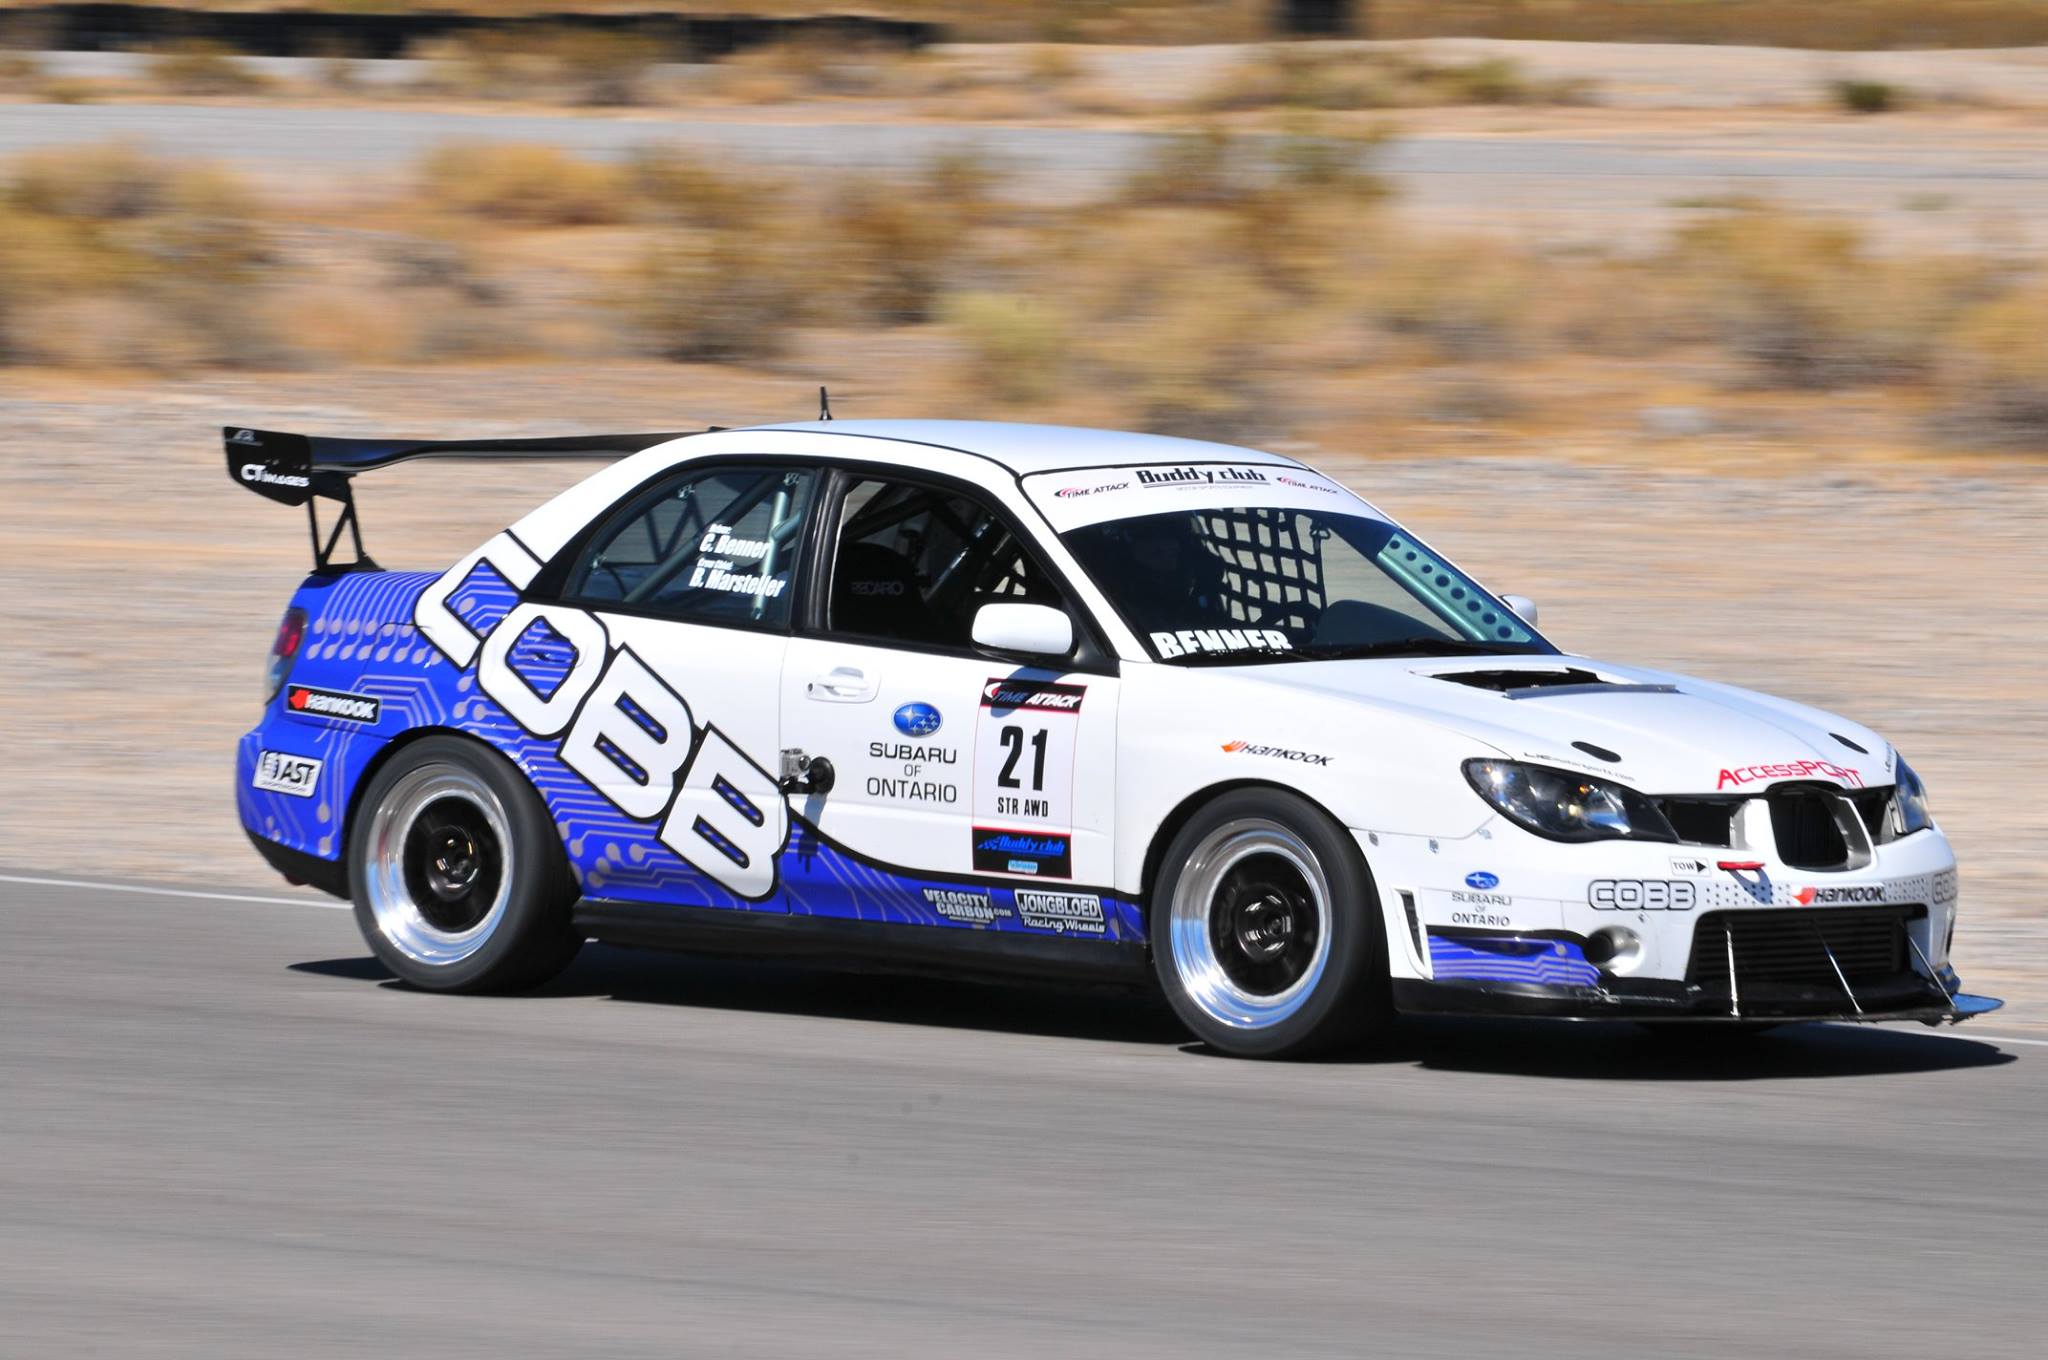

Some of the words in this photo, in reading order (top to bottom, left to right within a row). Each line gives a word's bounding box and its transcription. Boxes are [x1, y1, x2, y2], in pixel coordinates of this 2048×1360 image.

[1219, 469, 1268, 482] club
[1067, 486, 1090, 499] TIME
[1093, 481, 1131, 494] ATTACK
[699, 533, 716, 552] C.
[714, 534, 770, 559] Benner
[995, 690, 1029, 704] TIME
[1026, 692, 1083, 708] ATTACK
[414, 528, 790, 900] COBB
[869, 742, 957, 765] SUBARU
[997, 725, 1049, 791] 21
[904, 763, 922, 777] OF
[866, 777, 957, 803] ONTARIO
[997, 796, 1020, 815] STR
[1023, 799, 1049, 817] AWD
[1673, 861, 1696, 871] TOW
[923, 889, 988, 906] VELOCITY
[1452, 891, 1511, 906] SUBARU
[1587, 879, 1696, 910] COBB
[936, 902, 994, 919] CARBON
[1020, 894, 1097, 916] JONGBLOED
[1022, 917, 1064, 932] Racing
[1452, 912, 1510, 927] ONTARIO
